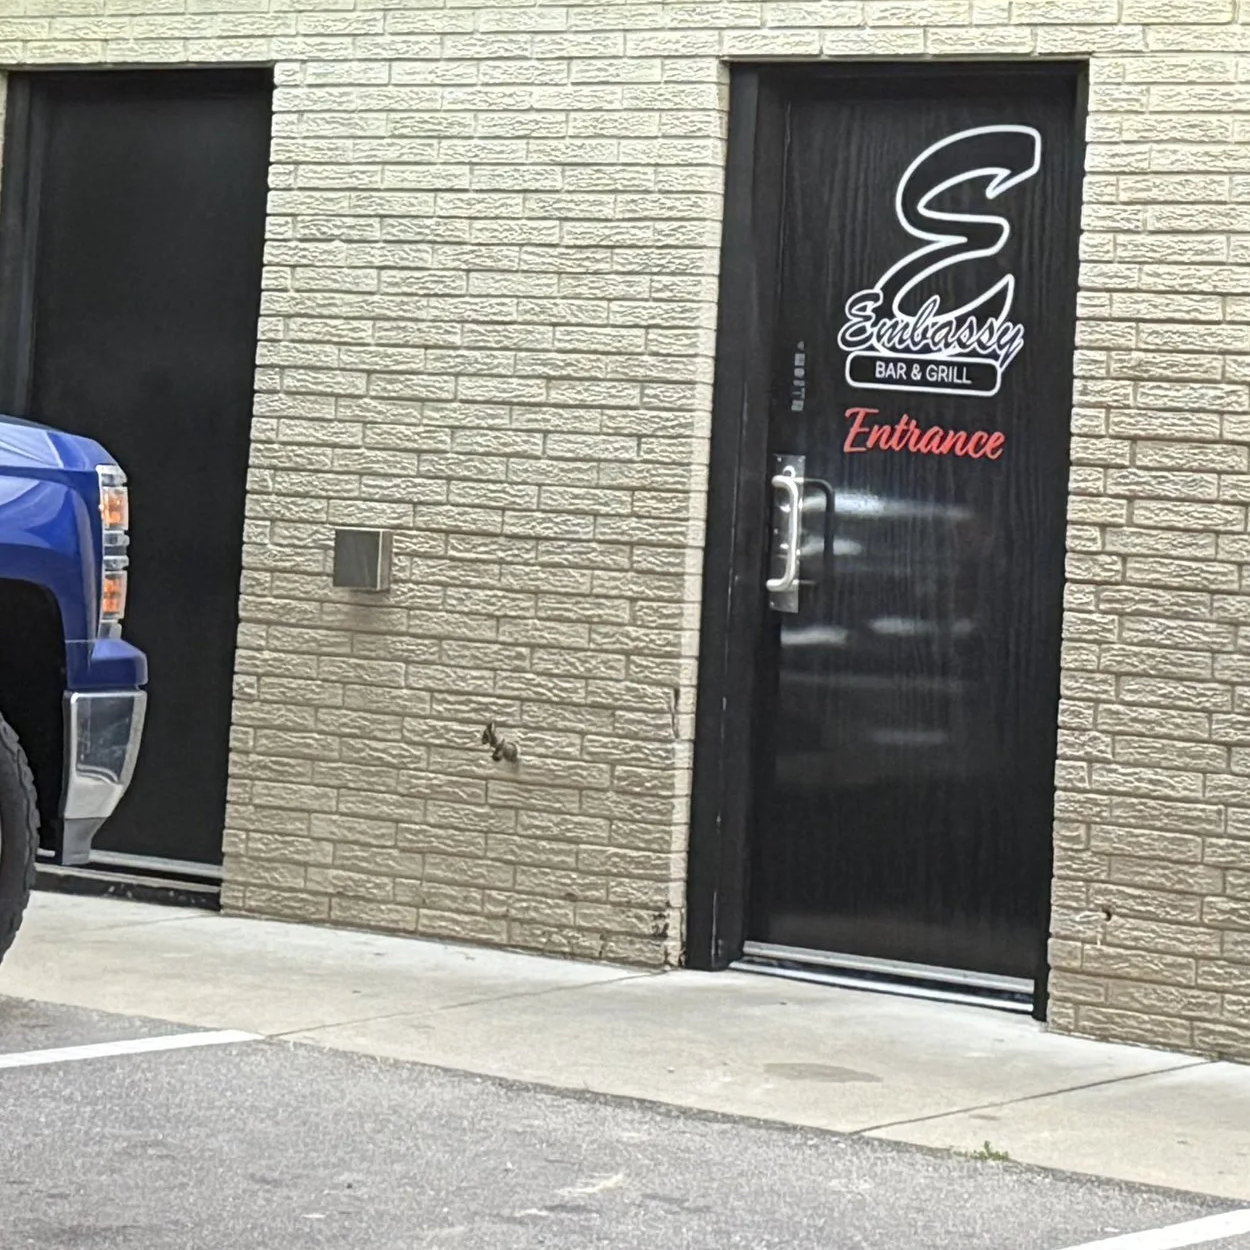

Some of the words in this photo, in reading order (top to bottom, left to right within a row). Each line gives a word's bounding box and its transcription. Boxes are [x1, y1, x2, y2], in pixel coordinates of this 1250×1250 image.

[837, 288, 1025, 370] Embassy
[875, 359, 907, 381] BAR
[910, 361, 923, 381] &
[925, 363, 973, 385] GRILL
[842, 406, 1006, 460] Entrance
